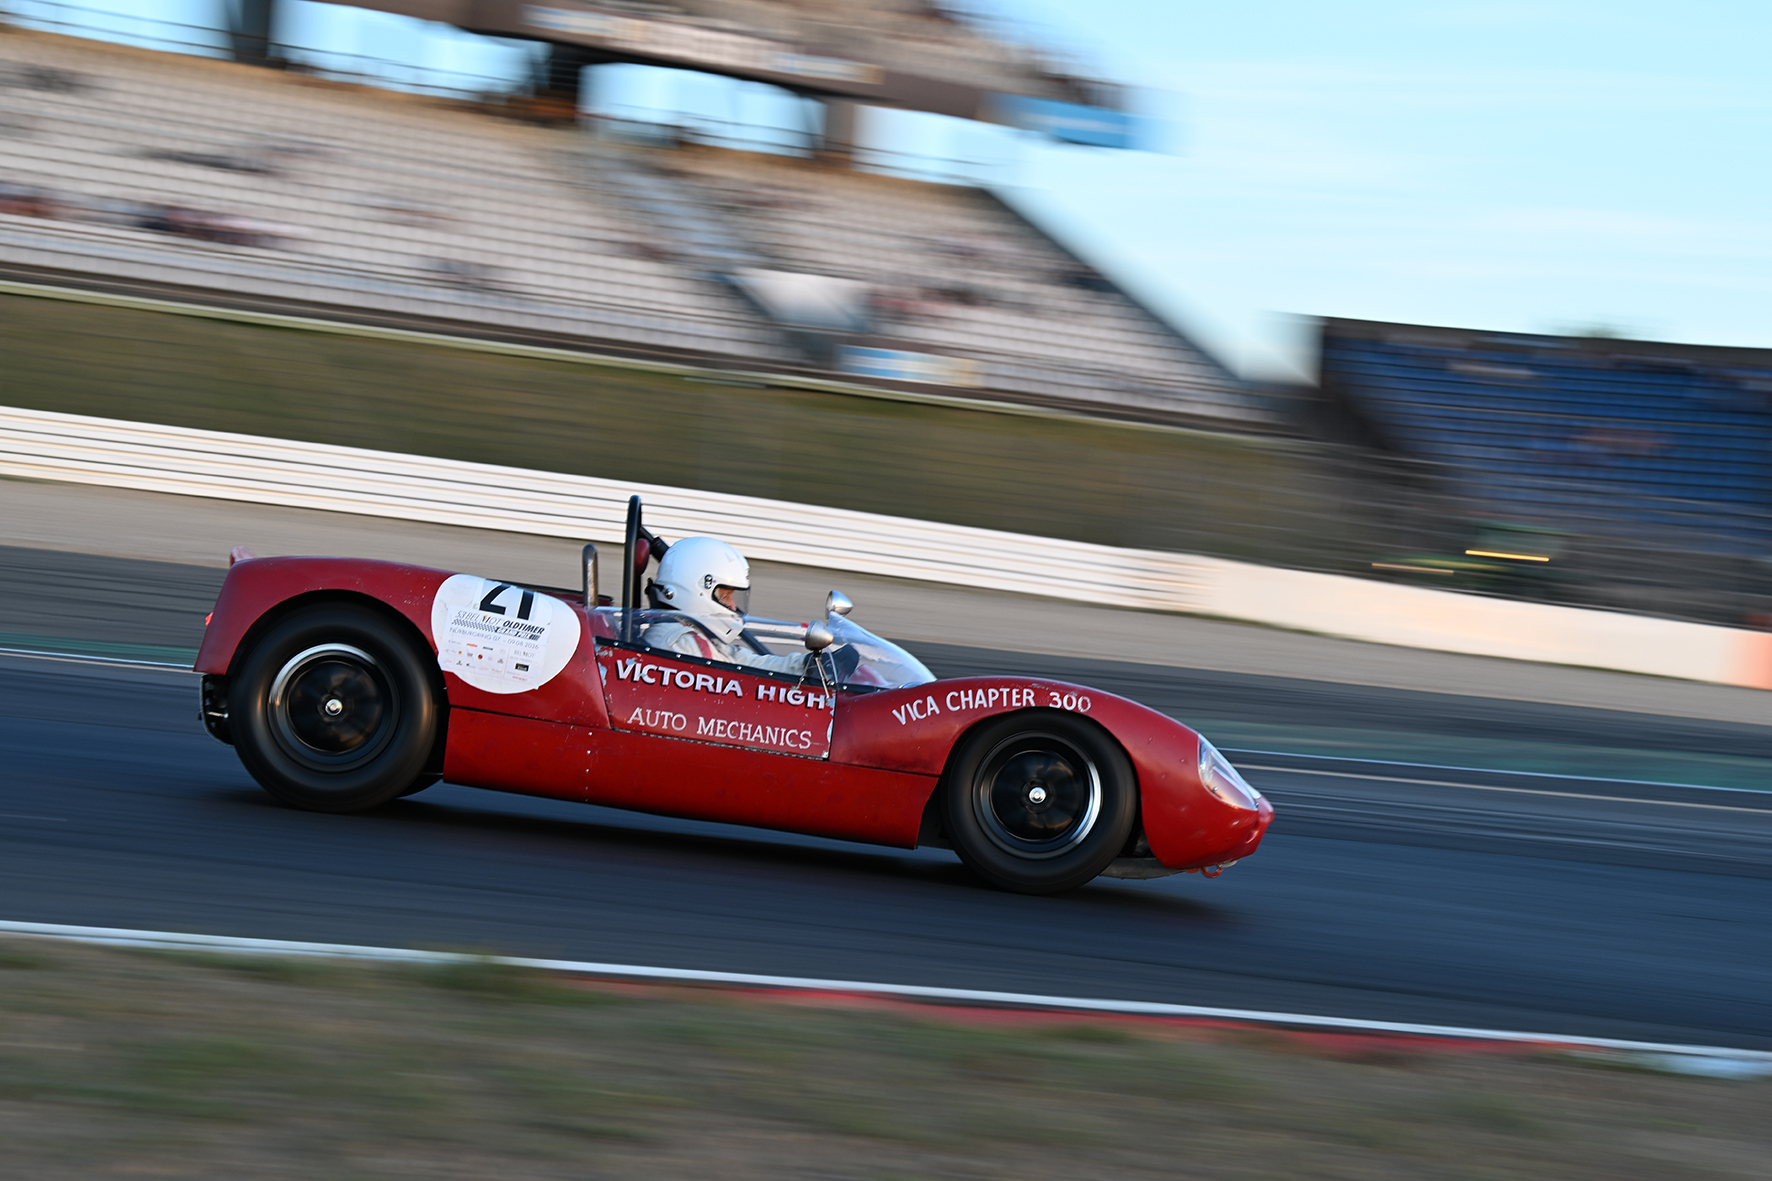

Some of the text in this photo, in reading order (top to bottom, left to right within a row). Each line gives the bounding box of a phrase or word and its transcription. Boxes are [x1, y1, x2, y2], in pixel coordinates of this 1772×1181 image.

[479, 583, 534, 621] 21
[502, 620, 545, 634] OLDTIMER
[615, 660, 825, 710] VICTORIA HIGH
[892, 687, 1092, 726] VICA CHAPTER 300
[627, 707, 812, 750] AUTO MECHANICS
